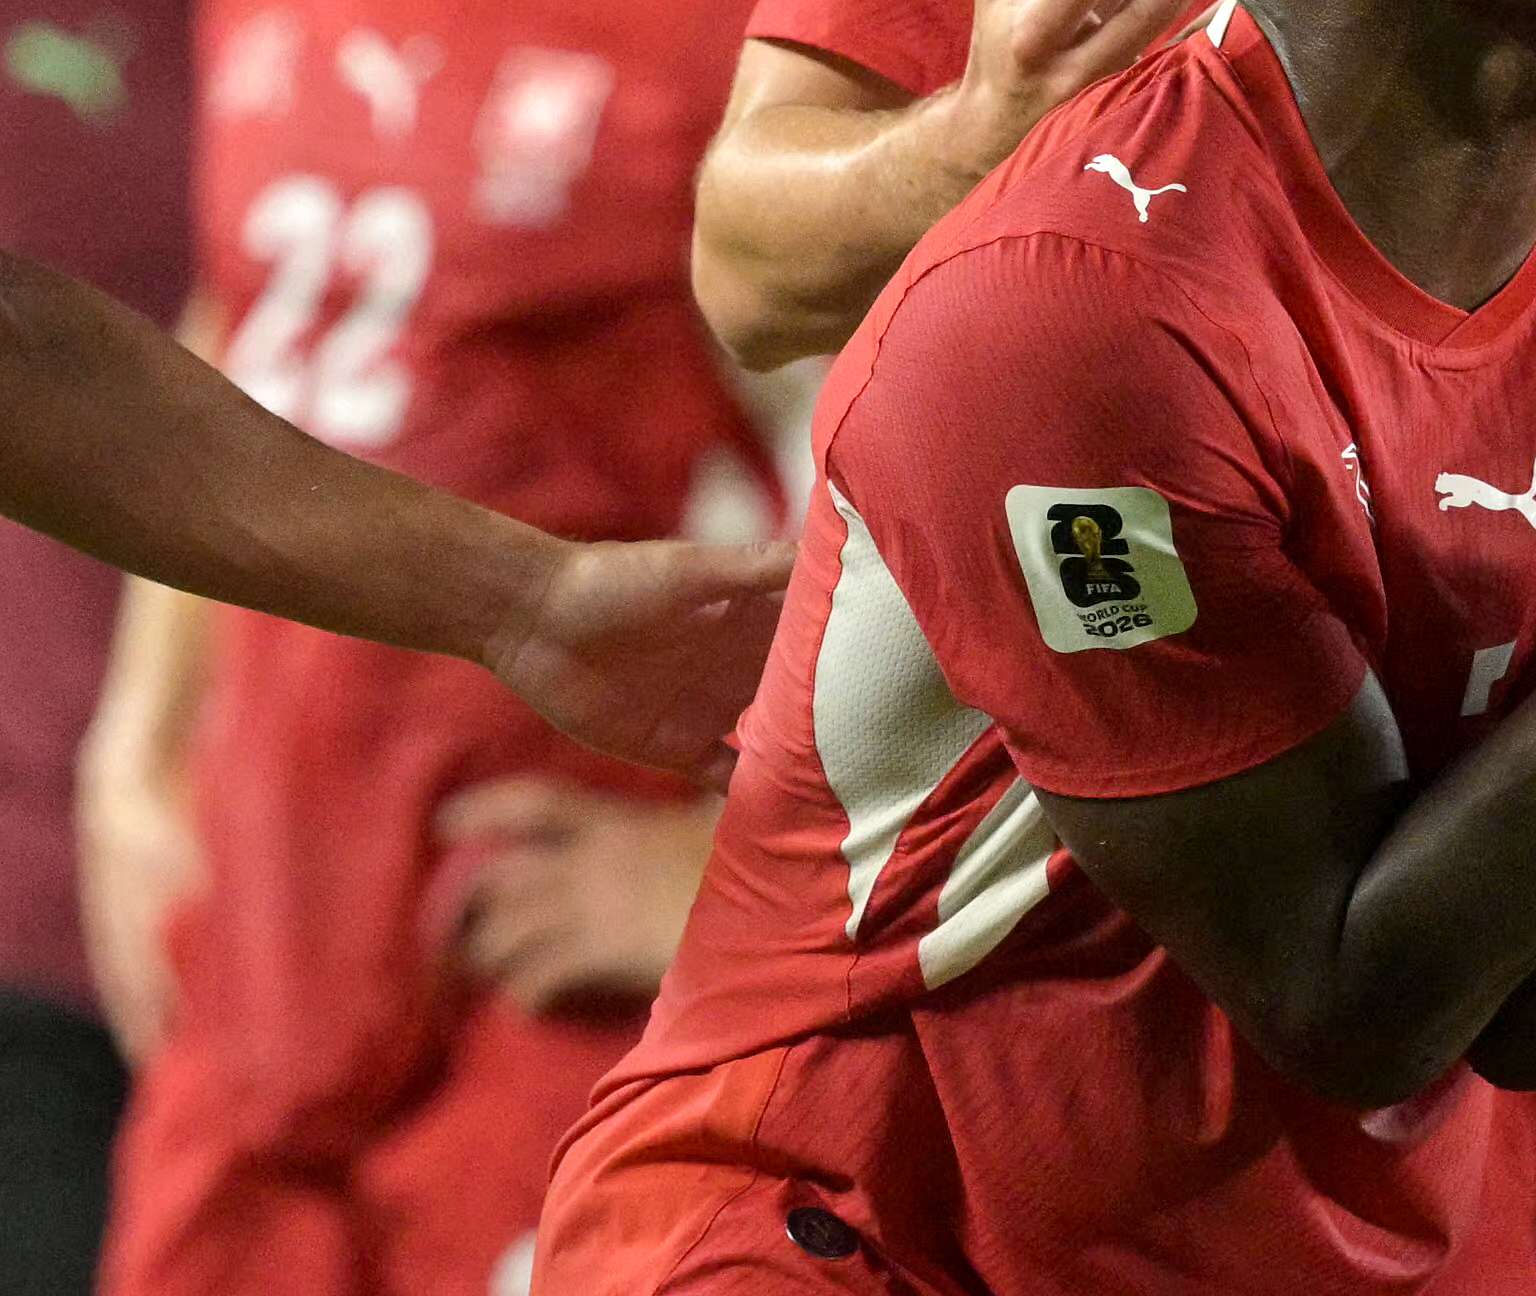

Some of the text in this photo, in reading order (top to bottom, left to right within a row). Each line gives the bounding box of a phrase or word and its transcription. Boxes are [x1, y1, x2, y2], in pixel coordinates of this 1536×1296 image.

[224, 172, 436, 447] 22
[1086, 583, 1121, 595] FIFA
[1077, 603, 1148, 623] WORLD CUP
[1083, 613, 1154, 638] 2026
